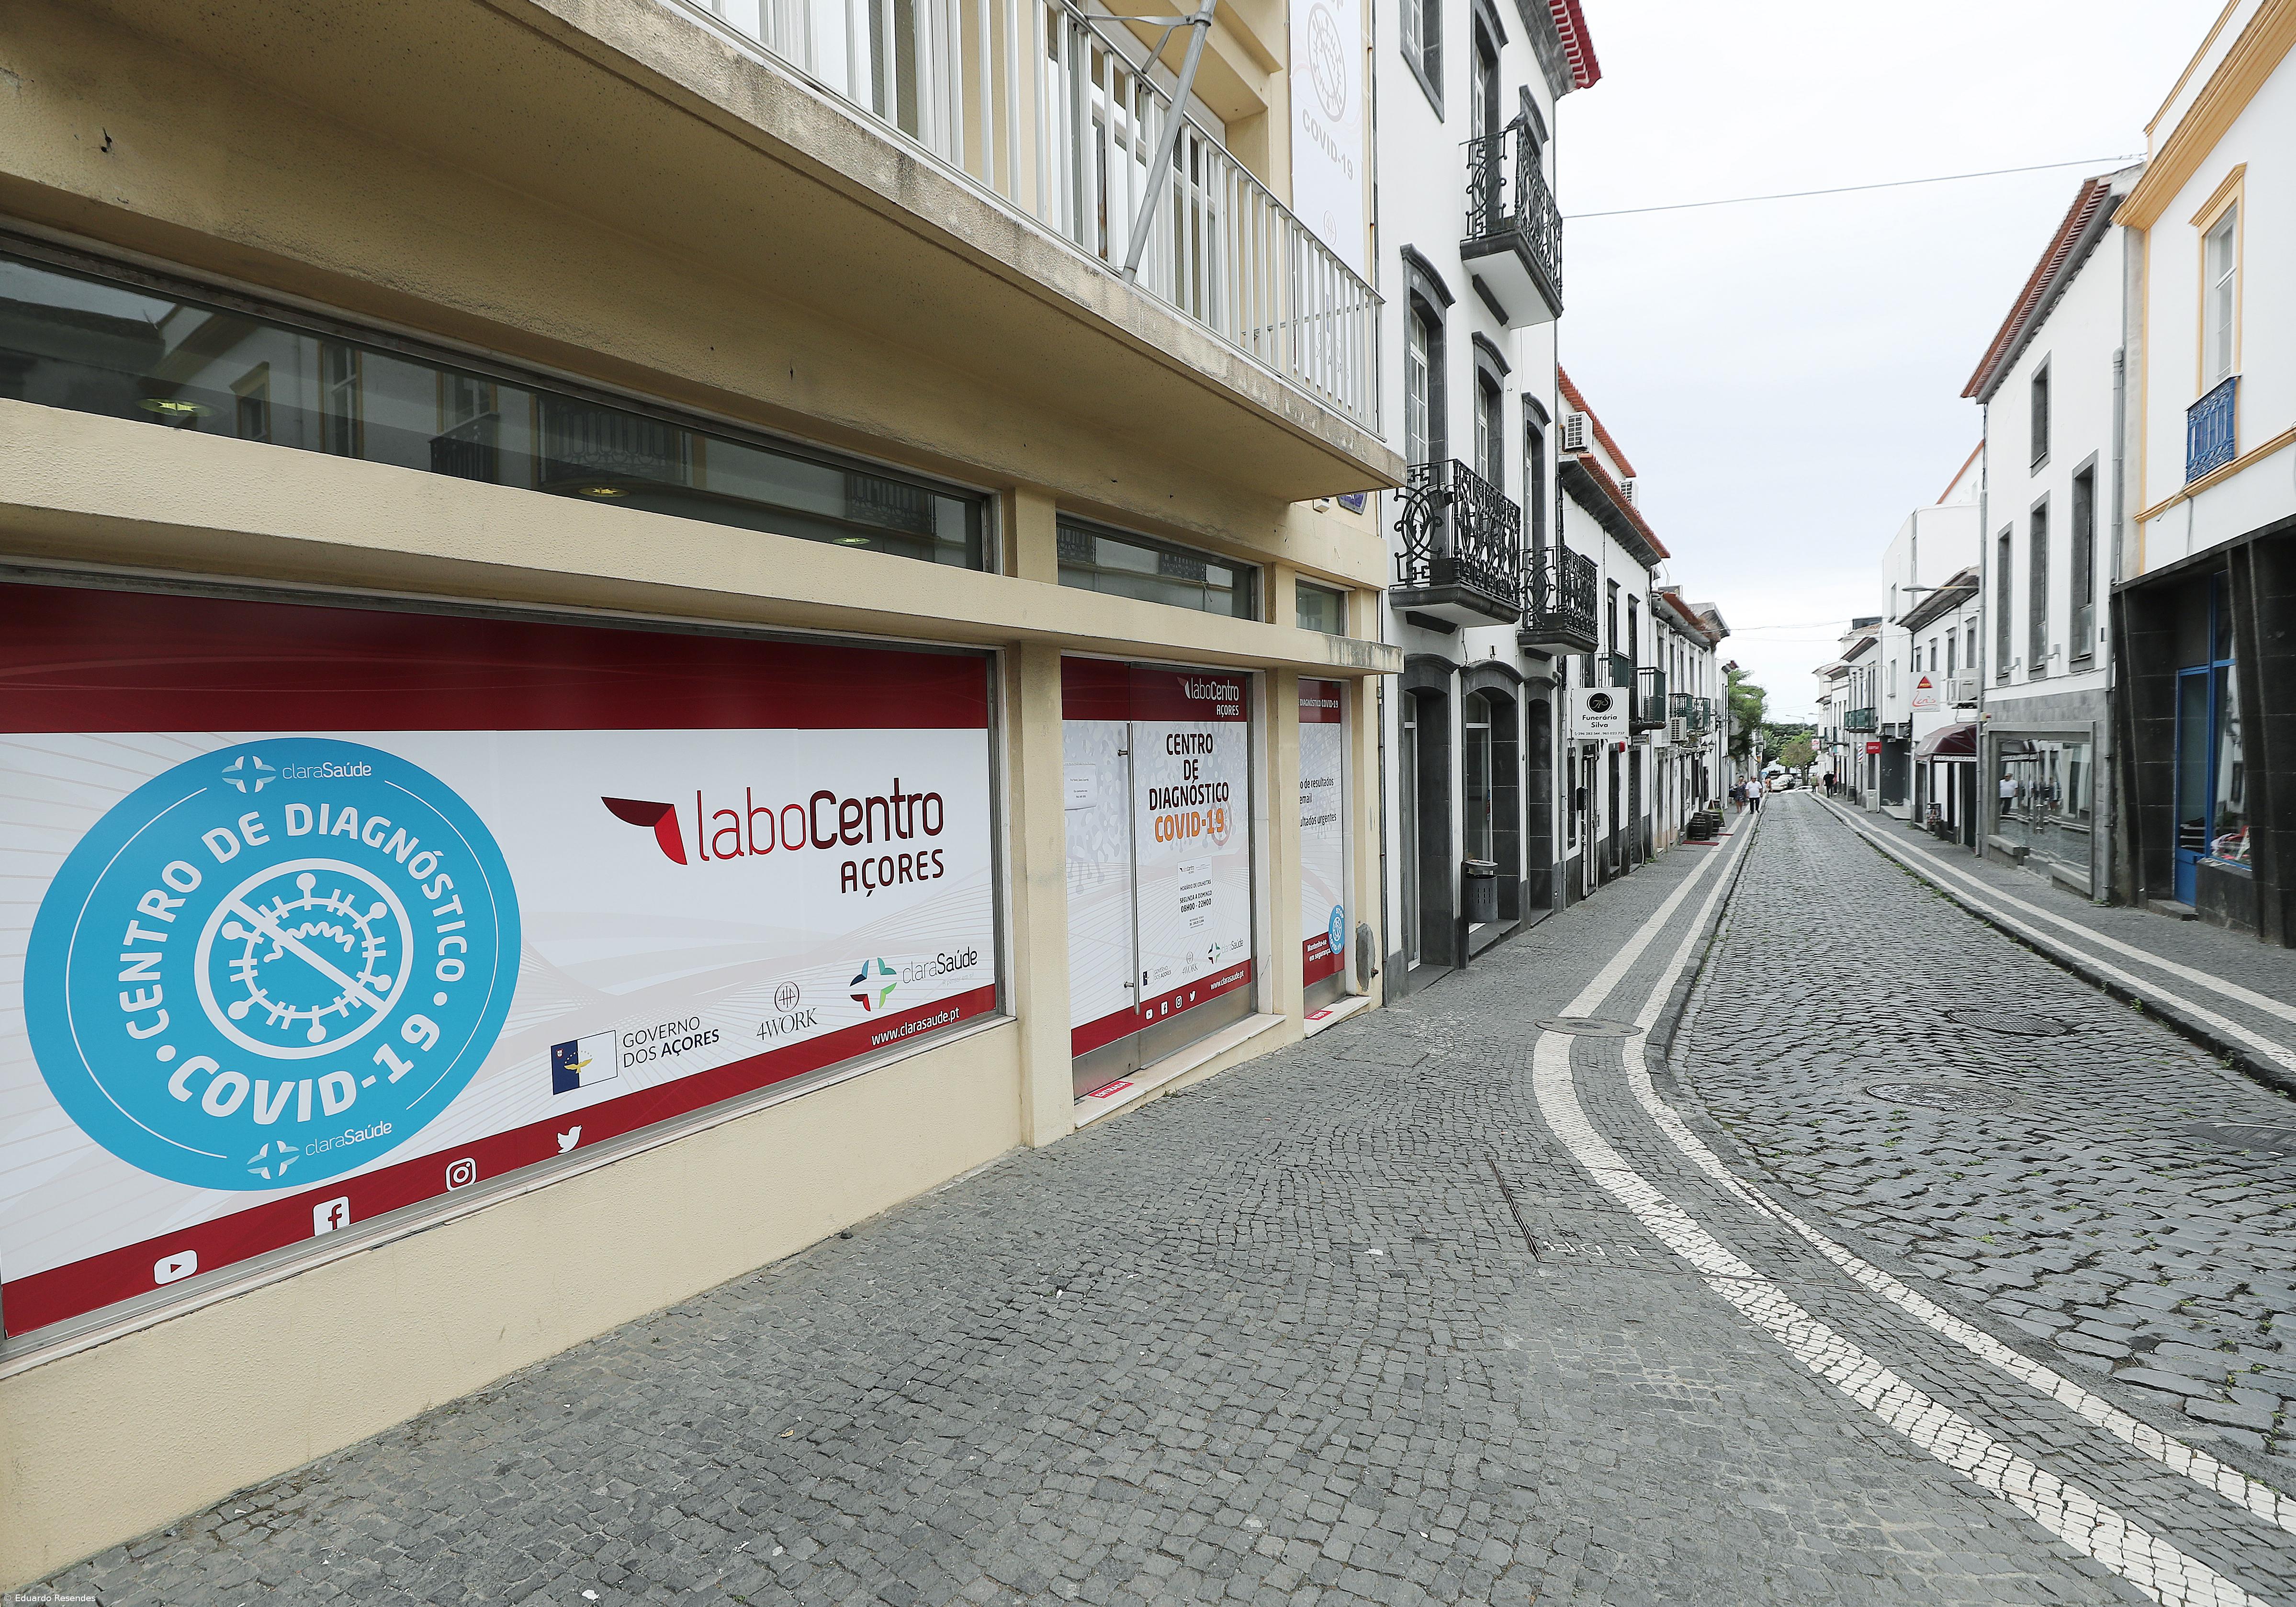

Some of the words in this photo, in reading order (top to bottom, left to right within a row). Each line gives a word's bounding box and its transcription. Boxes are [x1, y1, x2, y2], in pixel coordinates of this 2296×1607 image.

[1302, 108, 1353, 180] COVID-19
[1191, 678, 1239, 701] laboCentro
[1216, 704, 1239, 718] AÇORES
[1300, 698, 1321, 707] DIAGNÓSTICO
[1322, 700, 1339, 708] COVID-19
[1166, 734, 1213, 755] CENTRO
[281, 760, 372, 780] claraSaúde
[1183, 759, 1199, 780] DE
[1149, 779, 1229, 810] DIAGNÓSTICO
[1305, 778, 1310, 789] de
[1311, 777, 1334, 788] resultados
[696, 777, 944, 861] laboCentro
[1155, 808, 1225, 842] COVID-19
[1300, 815, 1317, 827] ultados
[1317, 814, 1337, 826] urgentes
[840, 849, 944, 897] AÇORES
[1180, 894, 1194, 904] SEGUNDA
[1181, 903, 1195, 913] 08H00
[1198, 898, 1211, 908] 22H00
[118, 859, 203, 1040] CENTRO
[202, 811, 270, 863] DE
[285, 802, 467, 982] DIAGNÓSTICO
[902, 946, 978, 984] claraSaúde
[1154, 965, 1169, 973] GOVERNO
[1160, 970, 1172, 979] AÇORES
[1210, 970, 1244, 990] www.clarasaude.pt
[623, 1017, 700, 1047] GOVERNO
[756, 1007, 818, 1041] 4WORK
[871, 1007, 960, 1046] www.clarasaude.pt
[623, 1046, 656, 1068] DOS
[661, 1029, 719, 1057] AÇORES
[167, 1013, 440, 1126] COVID-19
[305, 1120, 393, 1157] claraSaúde
